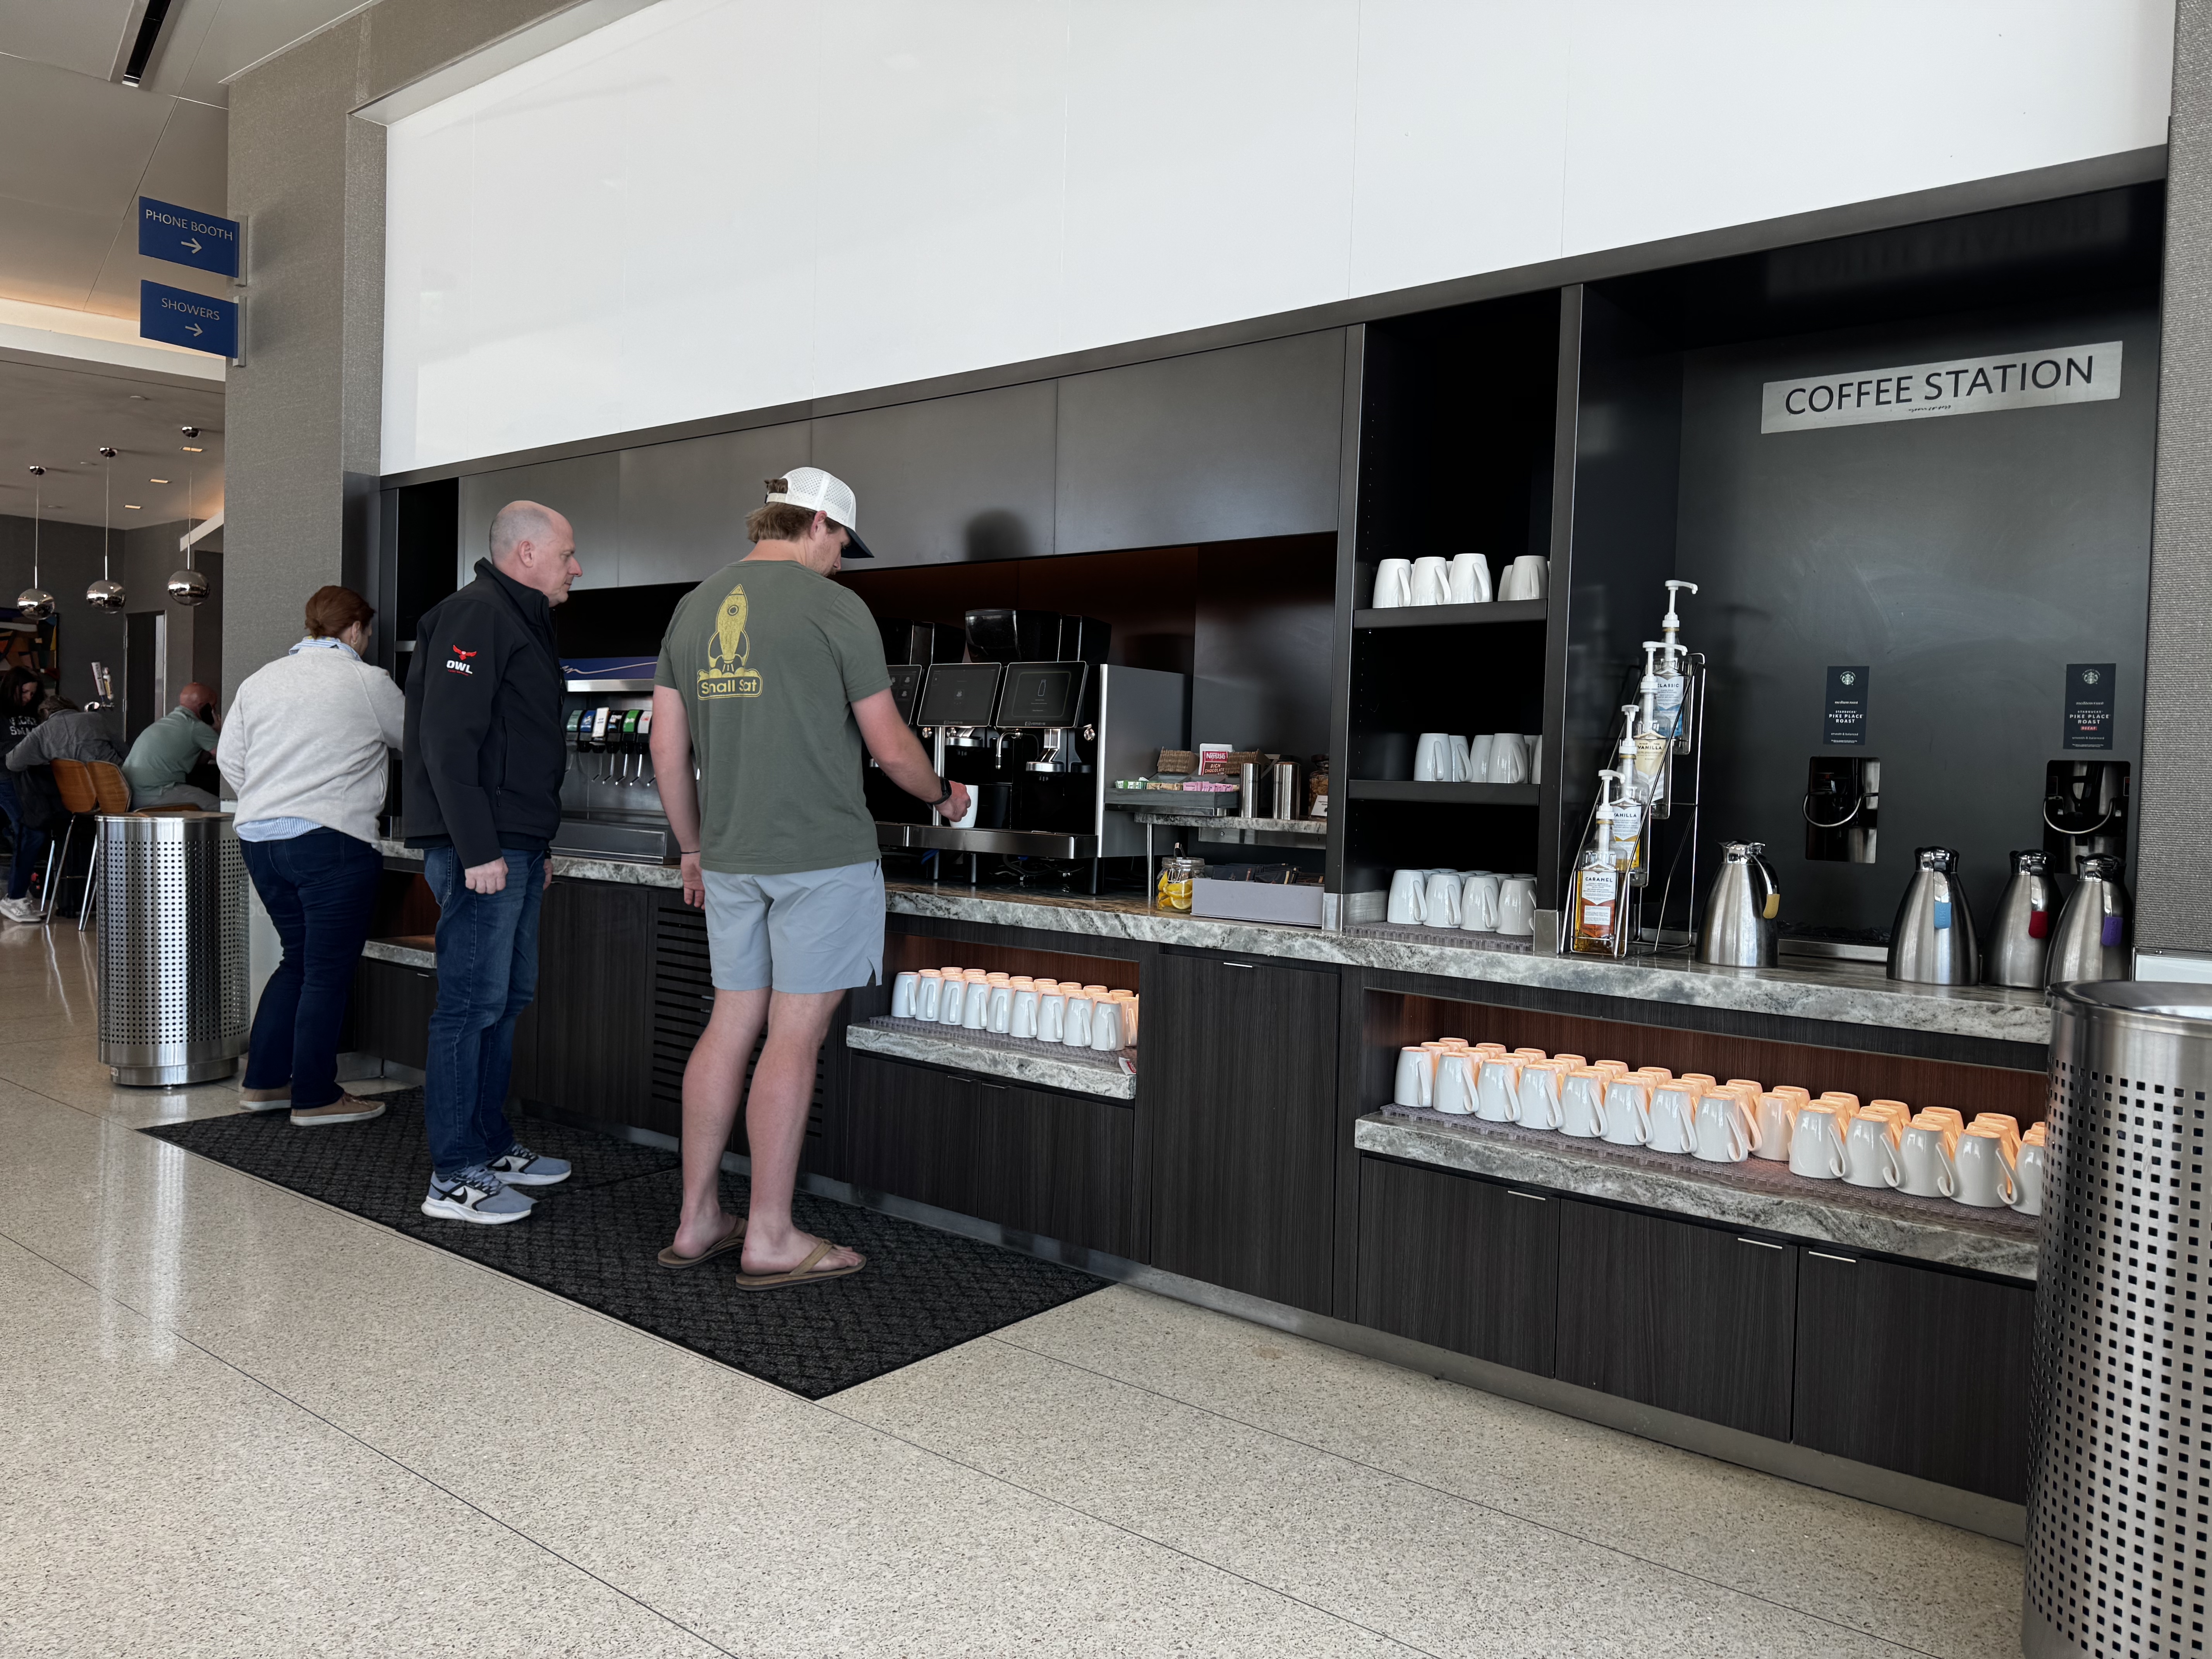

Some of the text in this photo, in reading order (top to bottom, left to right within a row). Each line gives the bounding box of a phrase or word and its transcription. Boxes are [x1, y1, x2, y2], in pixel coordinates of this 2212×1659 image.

[146, 209, 233, 241] PHONE BOOTH
[161, 298, 220, 320] SHOWERS
[1784, 355, 2093, 415] COFFEE STATION
[447, 660, 473, 674] OWL
[738, 679, 757, 692] Sat
